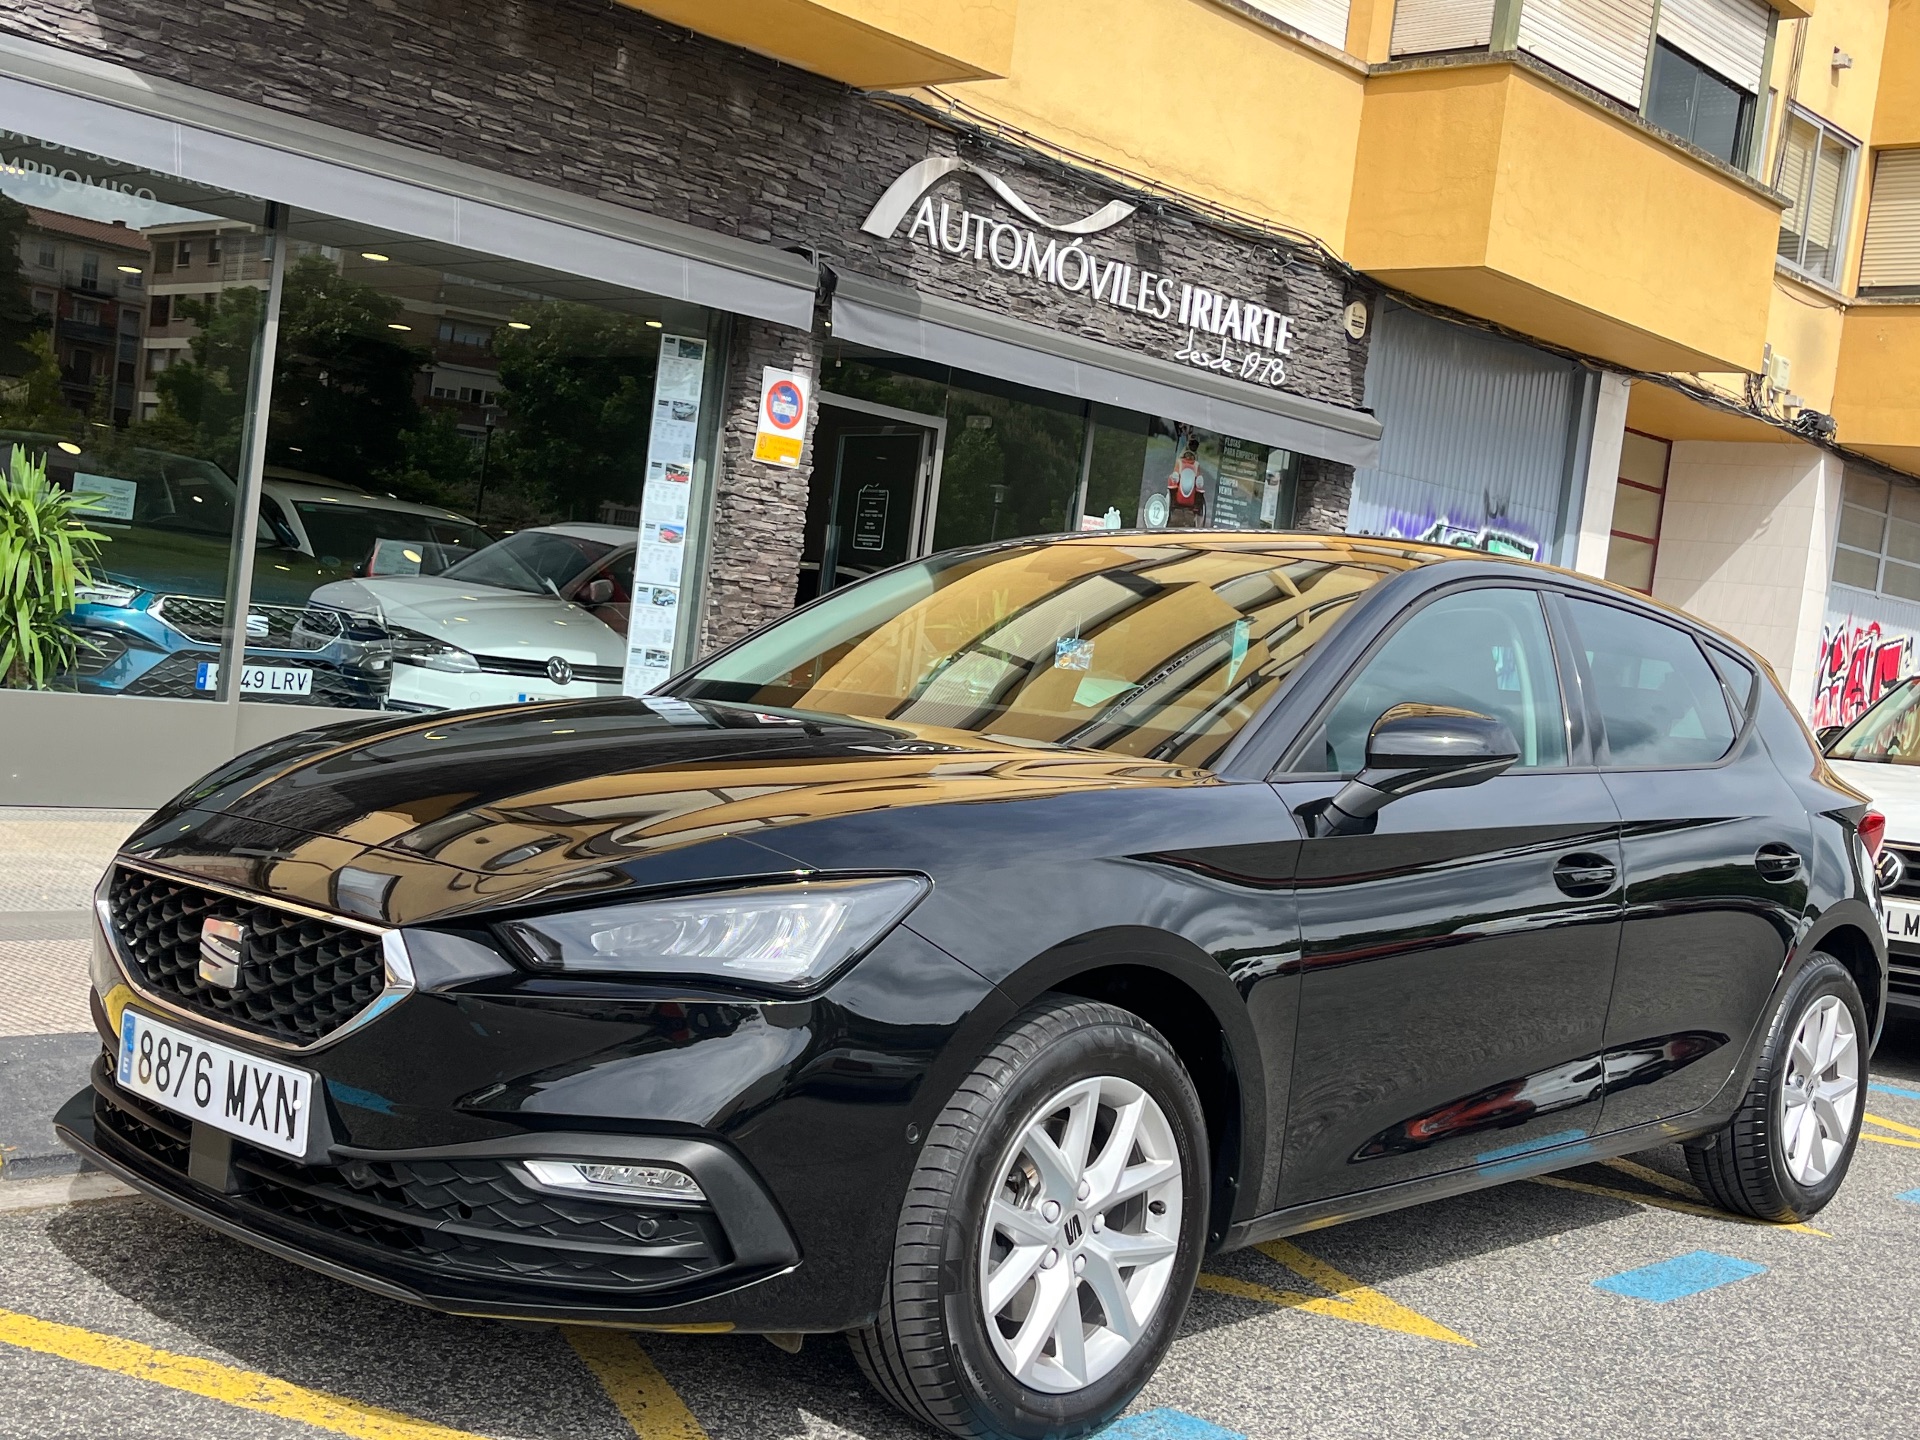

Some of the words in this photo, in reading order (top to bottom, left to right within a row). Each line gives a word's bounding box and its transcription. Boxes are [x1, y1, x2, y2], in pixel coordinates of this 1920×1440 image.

[907, 196, 1173, 319] AUTOMÓVILES
[1178, 284, 1294, 356] IRIARTE
[1175, 328, 1234, 373] desde
[1241, 352, 1286, 386] 1978
[1219, 476, 1238, 488] COMPRA
[271, 671, 308, 691] LRV
[1886, 910, 1920, 938] LM
[122, 1059, 130, 1074] E
[138, 1029, 213, 1108] 8876
[225, 1059, 299, 1140] MXN
